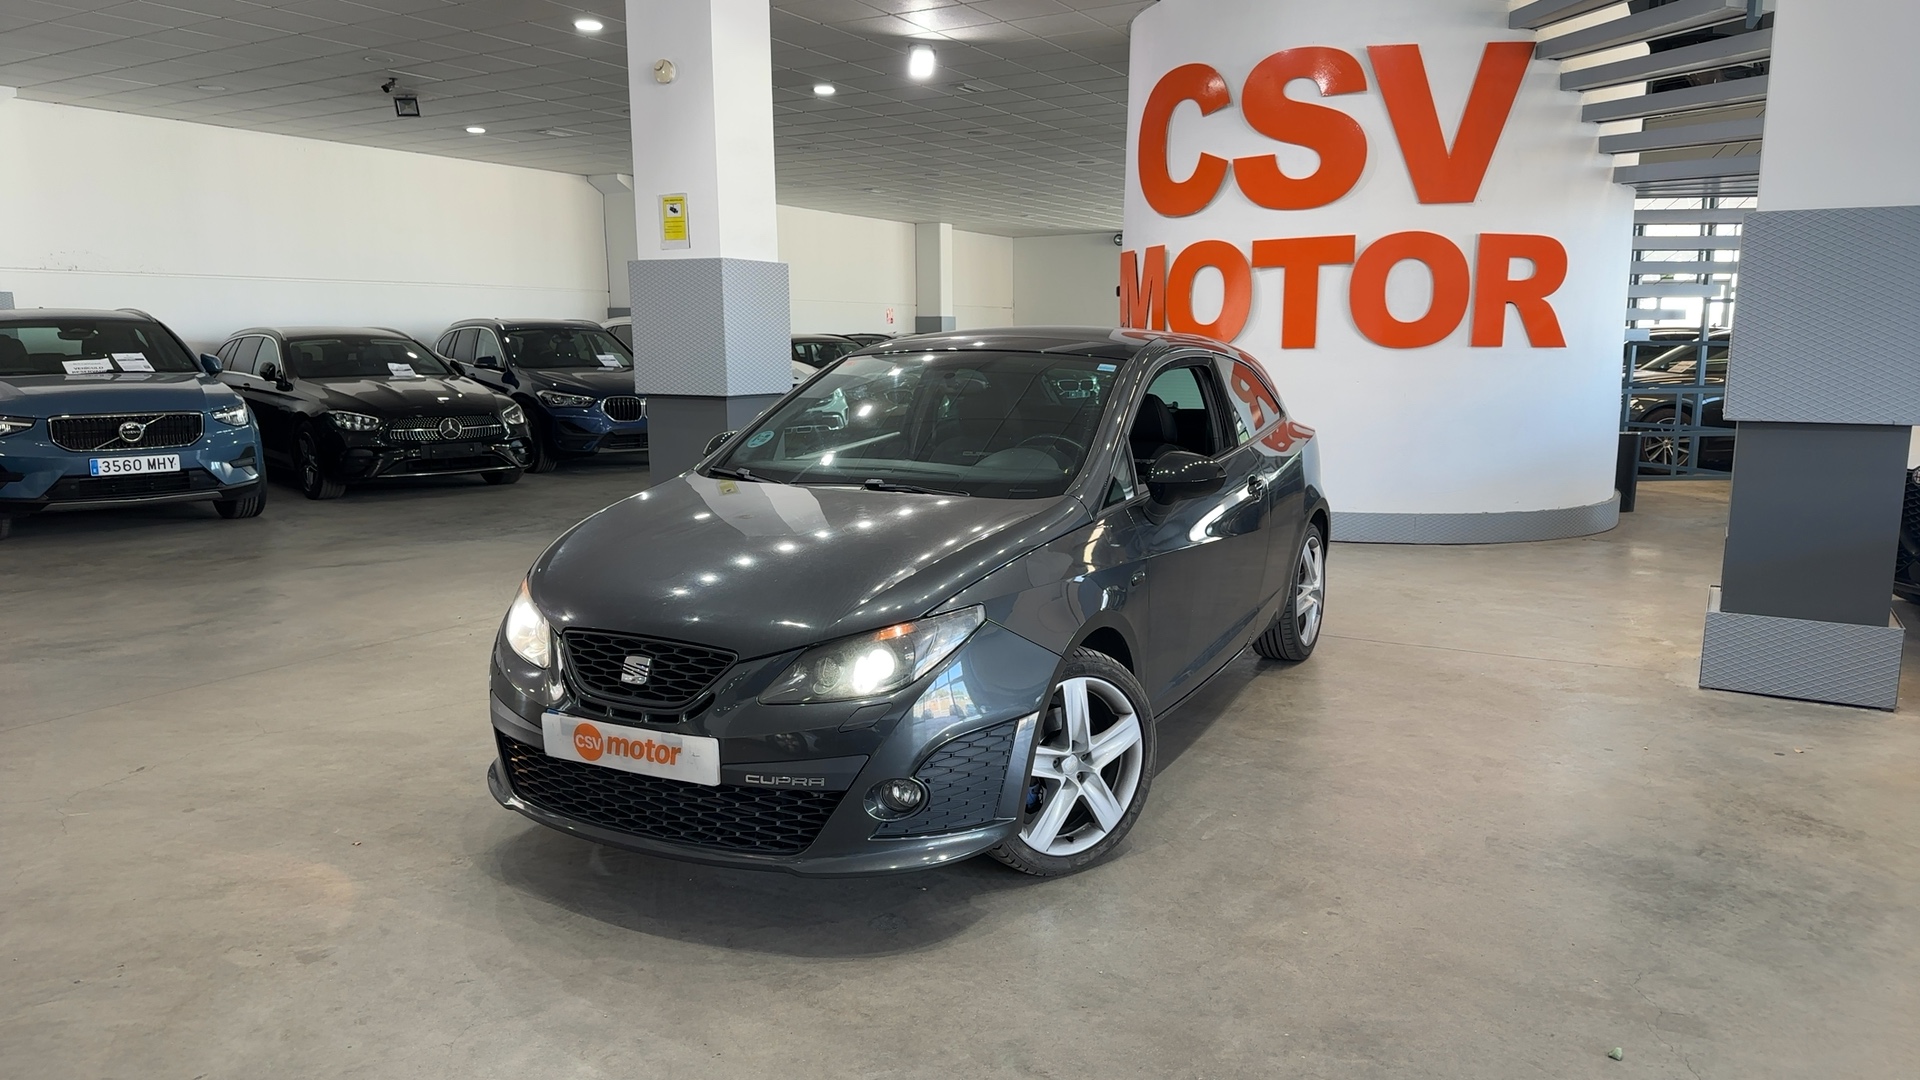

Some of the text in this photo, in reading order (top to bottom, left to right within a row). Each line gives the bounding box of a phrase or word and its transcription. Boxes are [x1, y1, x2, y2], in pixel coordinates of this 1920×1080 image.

[1138, 42, 1536, 217] CSV
[1120, 231, 1568, 349] MOTOR
[102, 457, 175, 473] 3560 MHY
[607, 735, 682, 766] motor
[745, 774, 825, 786] CUPRA
